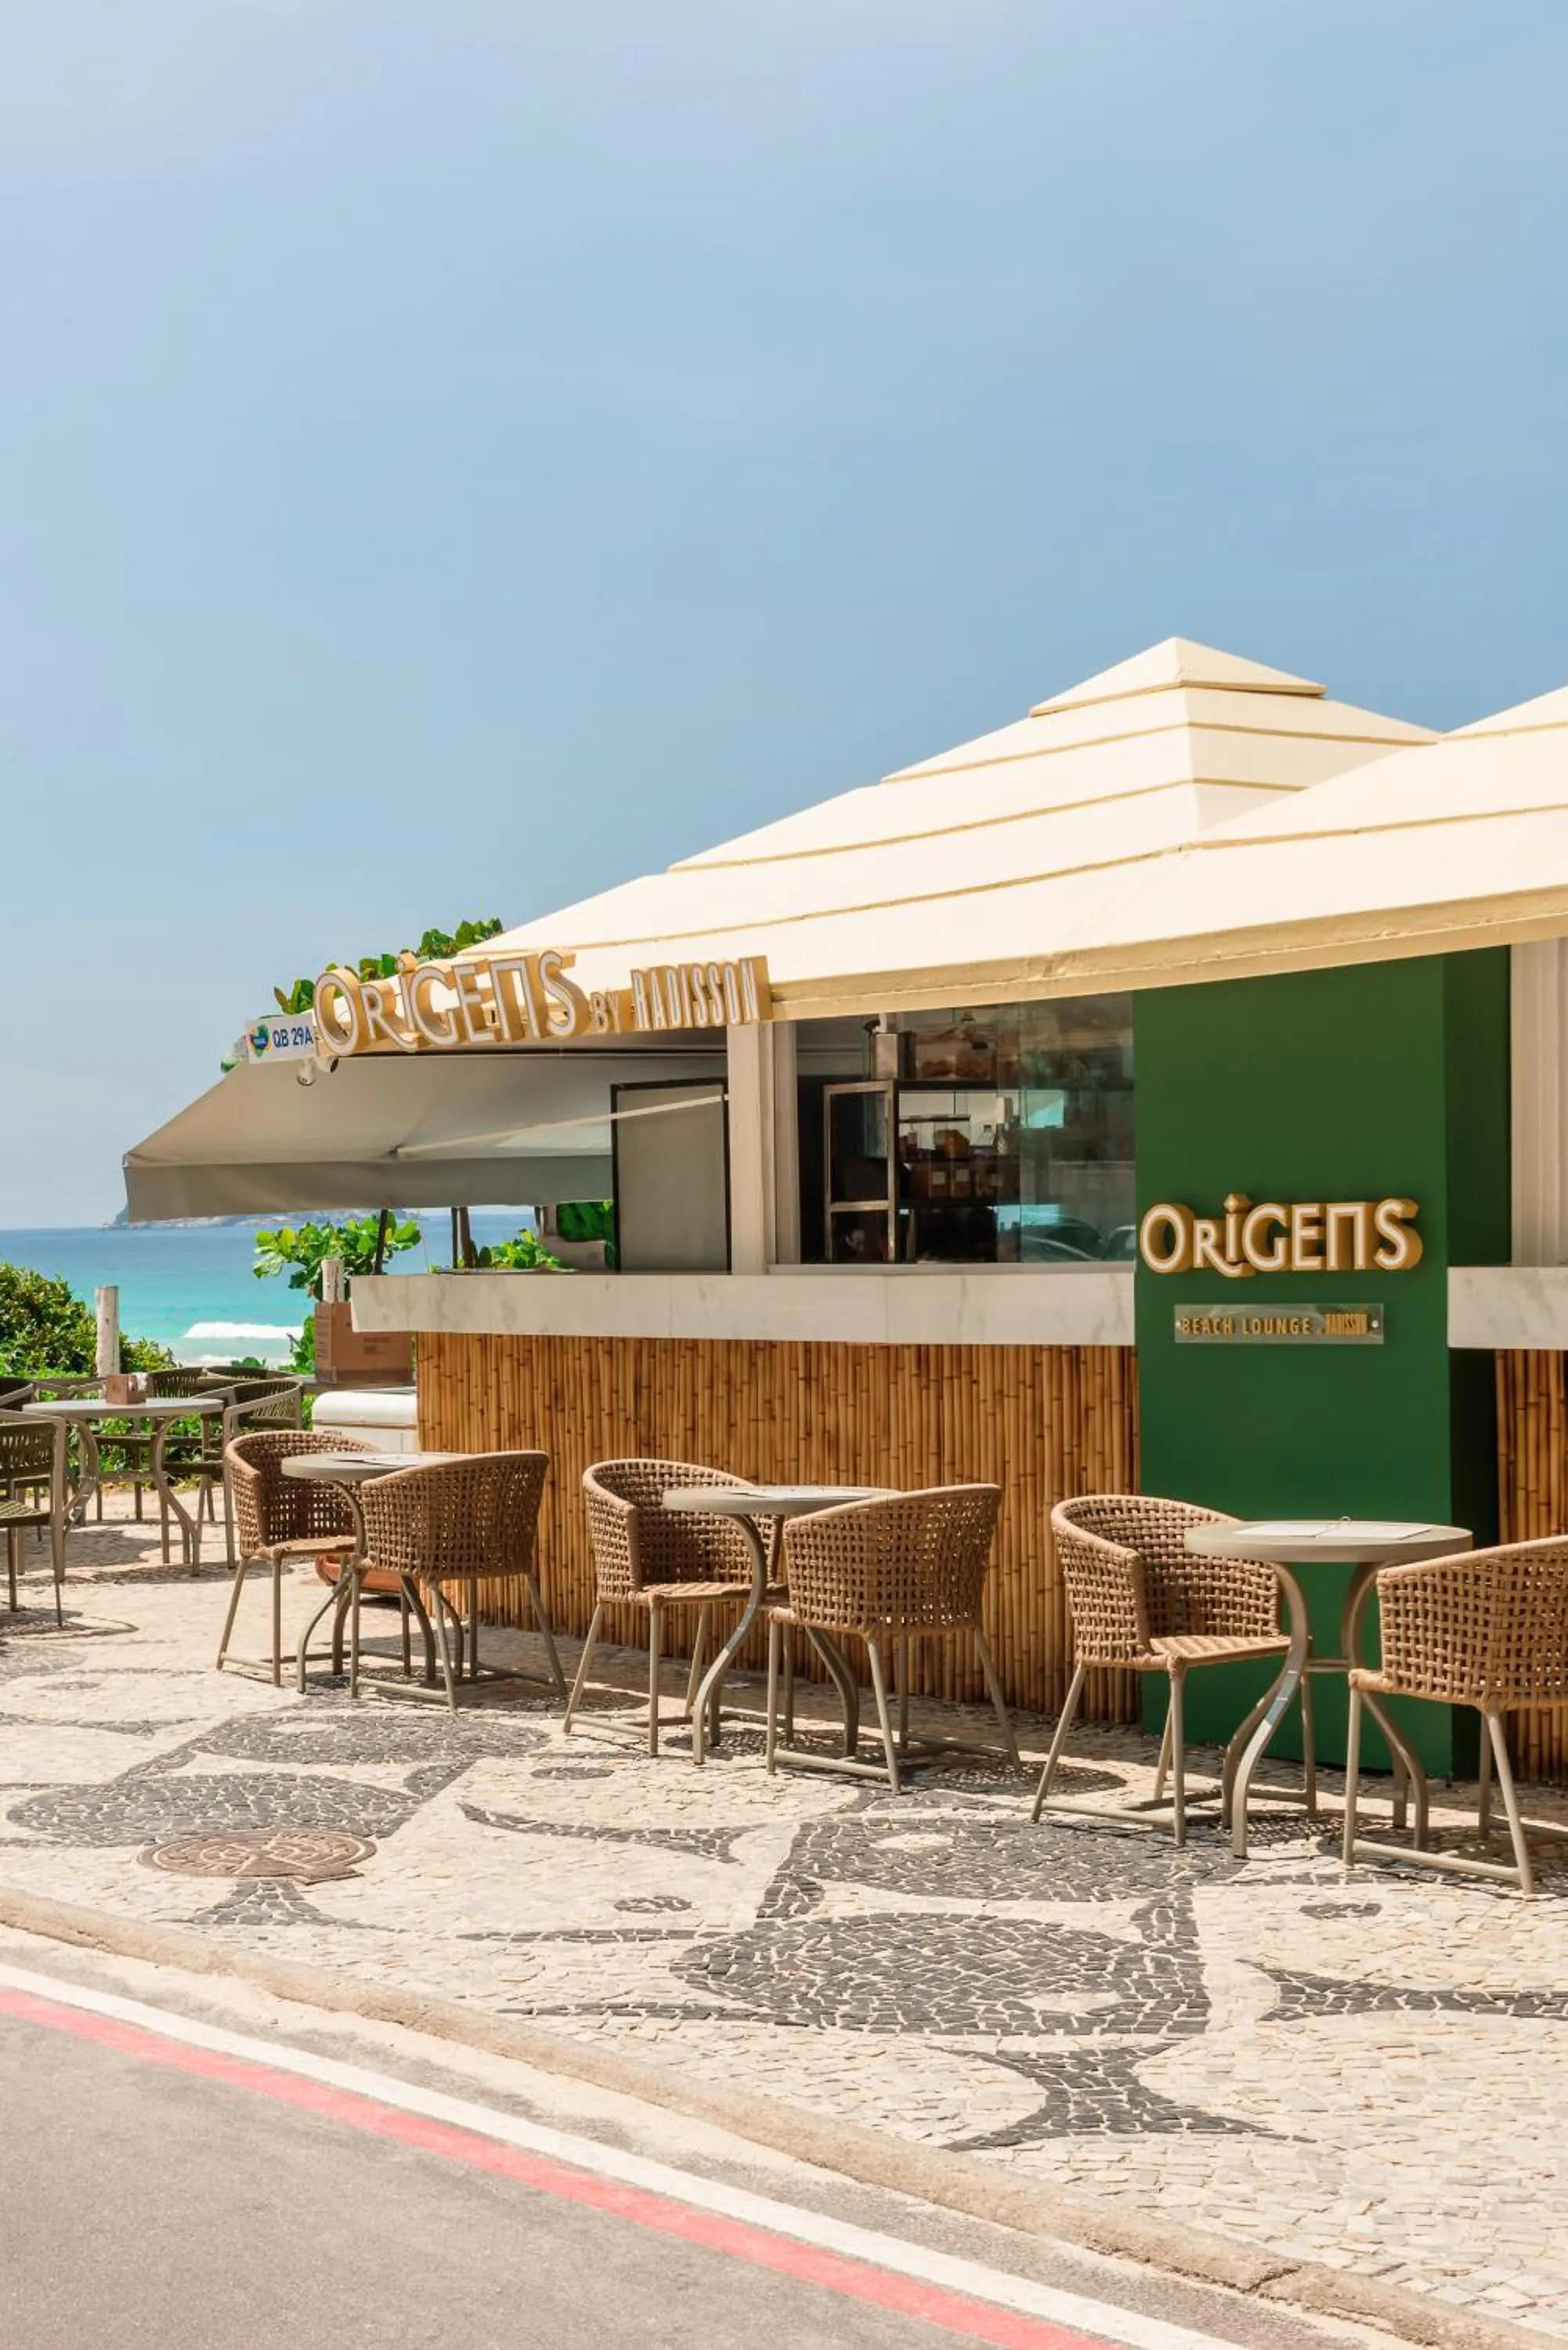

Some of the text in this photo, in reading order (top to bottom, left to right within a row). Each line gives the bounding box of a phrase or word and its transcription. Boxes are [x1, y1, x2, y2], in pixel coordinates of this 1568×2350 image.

[590, 990, 623, 1034] BY
[630, 955, 772, 1032] RADISSON
[273, 1025, 314, 1048] QB 29A
[1180, 1317, 1234, 1336] BEACH
[1242, 1317, 1313, 1336] LOUNGE
